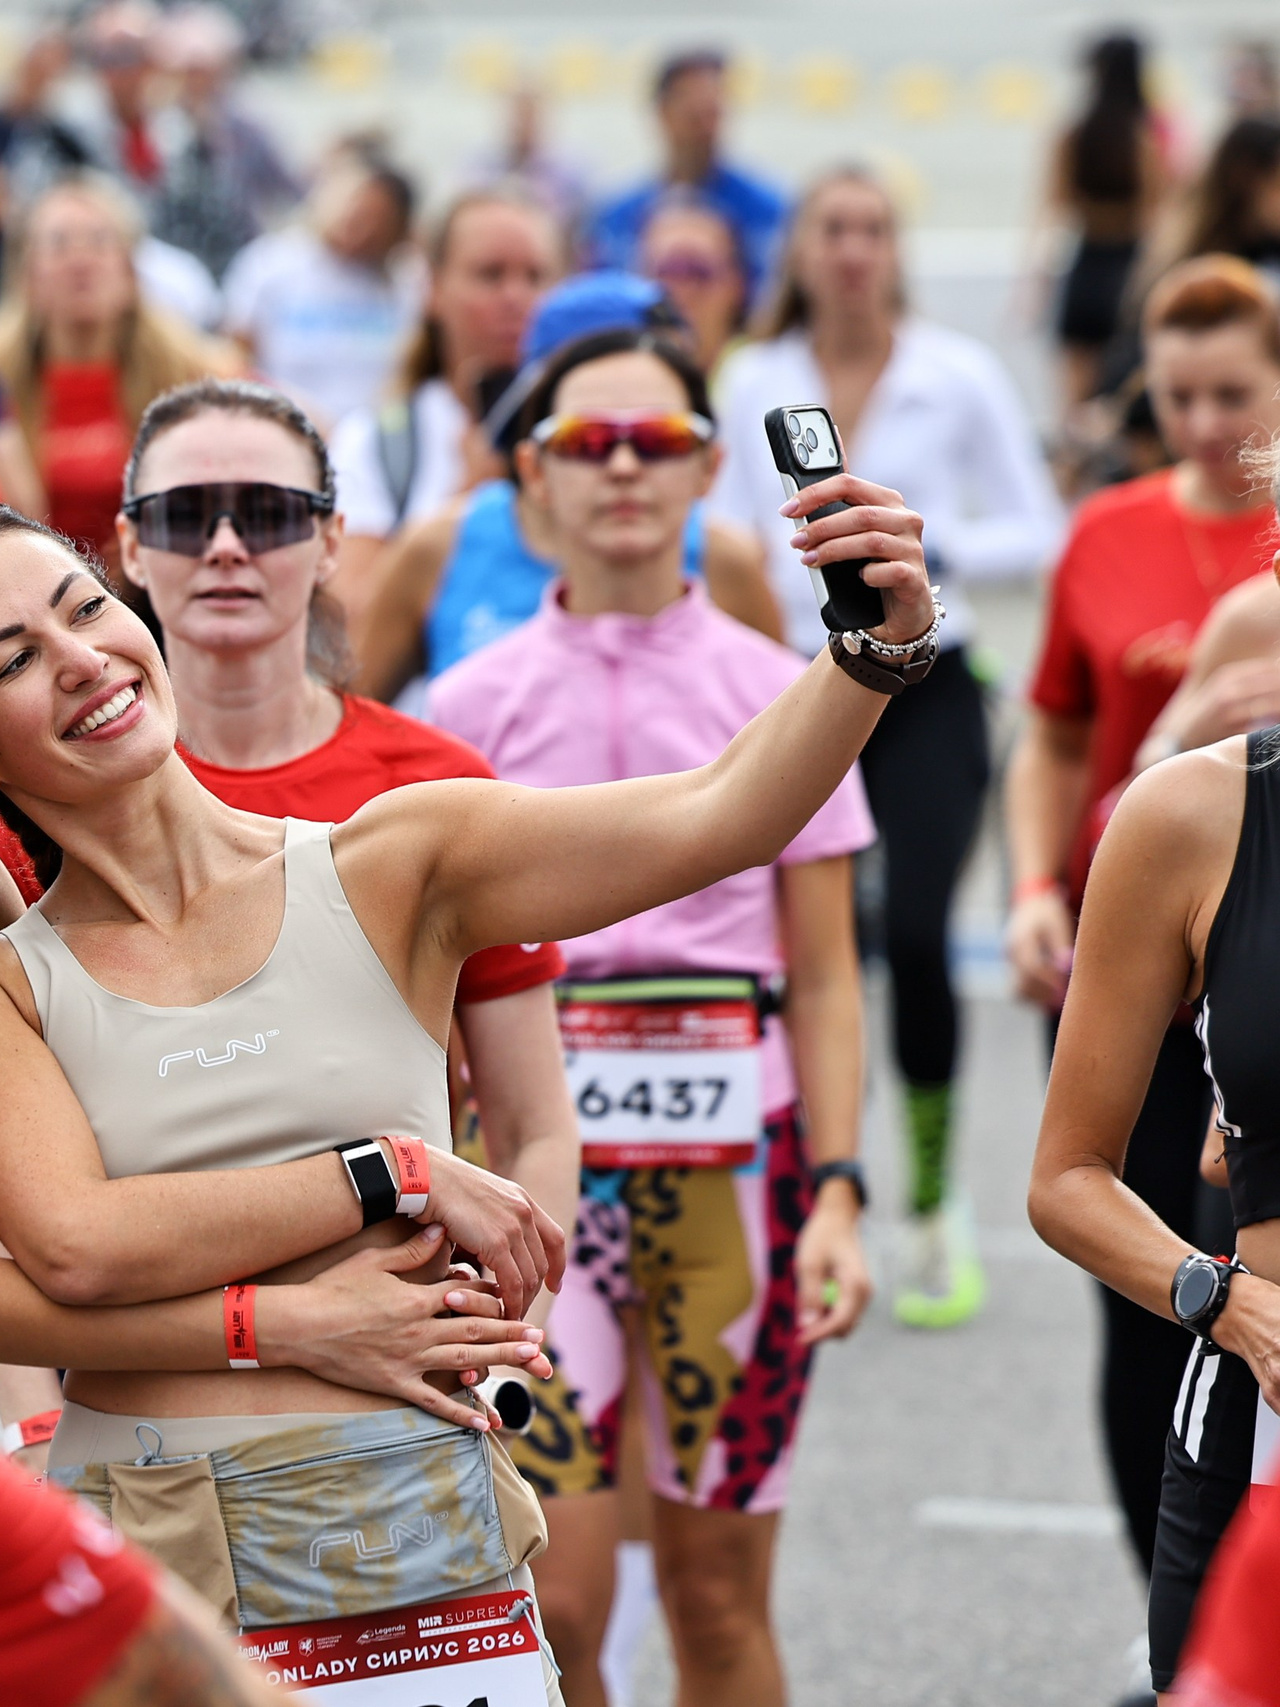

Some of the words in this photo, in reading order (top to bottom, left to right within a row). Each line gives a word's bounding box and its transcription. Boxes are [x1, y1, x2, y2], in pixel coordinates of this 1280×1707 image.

[577, 1076, 729, 1120] 6437
[417, 1615, 443, 1629] MIR
[445, 1604, 510, 1625] SUPREM
[374, 1624, 406, 1636] Legenda
[265, 1657, 358, 1686] ONLADY
[366, 1641, 460, 1670] СИРИУС
[467, 1630, 526, 1654] 2026
[268, 1640, 289, 1654] LADY
